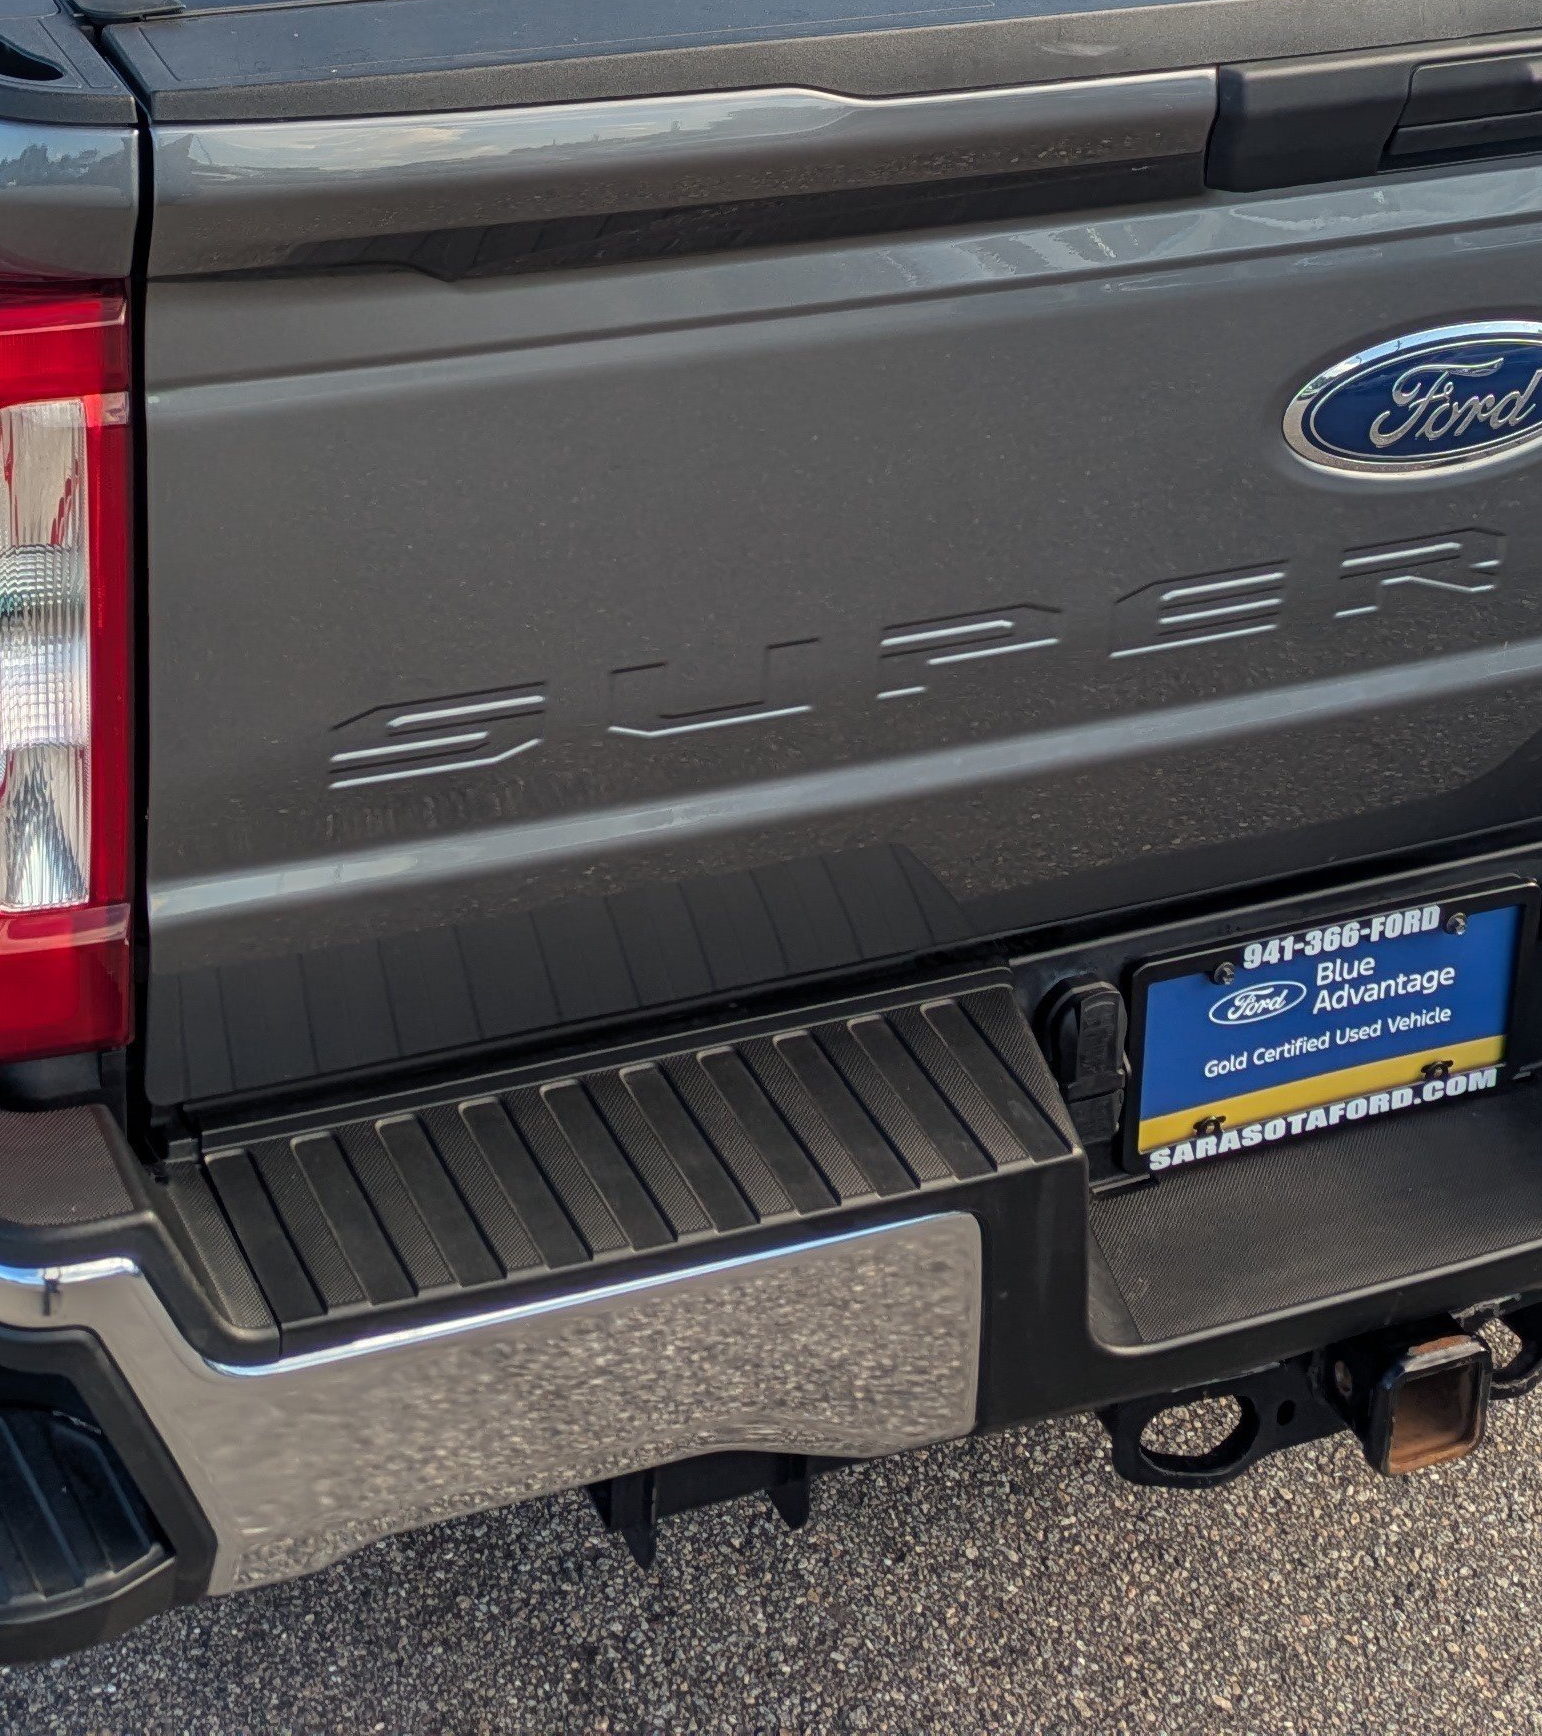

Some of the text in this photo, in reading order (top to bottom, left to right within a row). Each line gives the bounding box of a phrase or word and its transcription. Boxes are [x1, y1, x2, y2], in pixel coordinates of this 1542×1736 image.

[328, 525, 1510, 790] SUPER
[1243, 905, 1442, 970] 941-366-FORD
[1316, 956, 1377, 987] Blue
[1227, 966, 1456, 1021] Ford Advantage
[1203, 1005, 1453, 1079] Gold Certified Used Vehicle
[1148, 1067, 1499, 1171] SARASOTAFORD.COM
